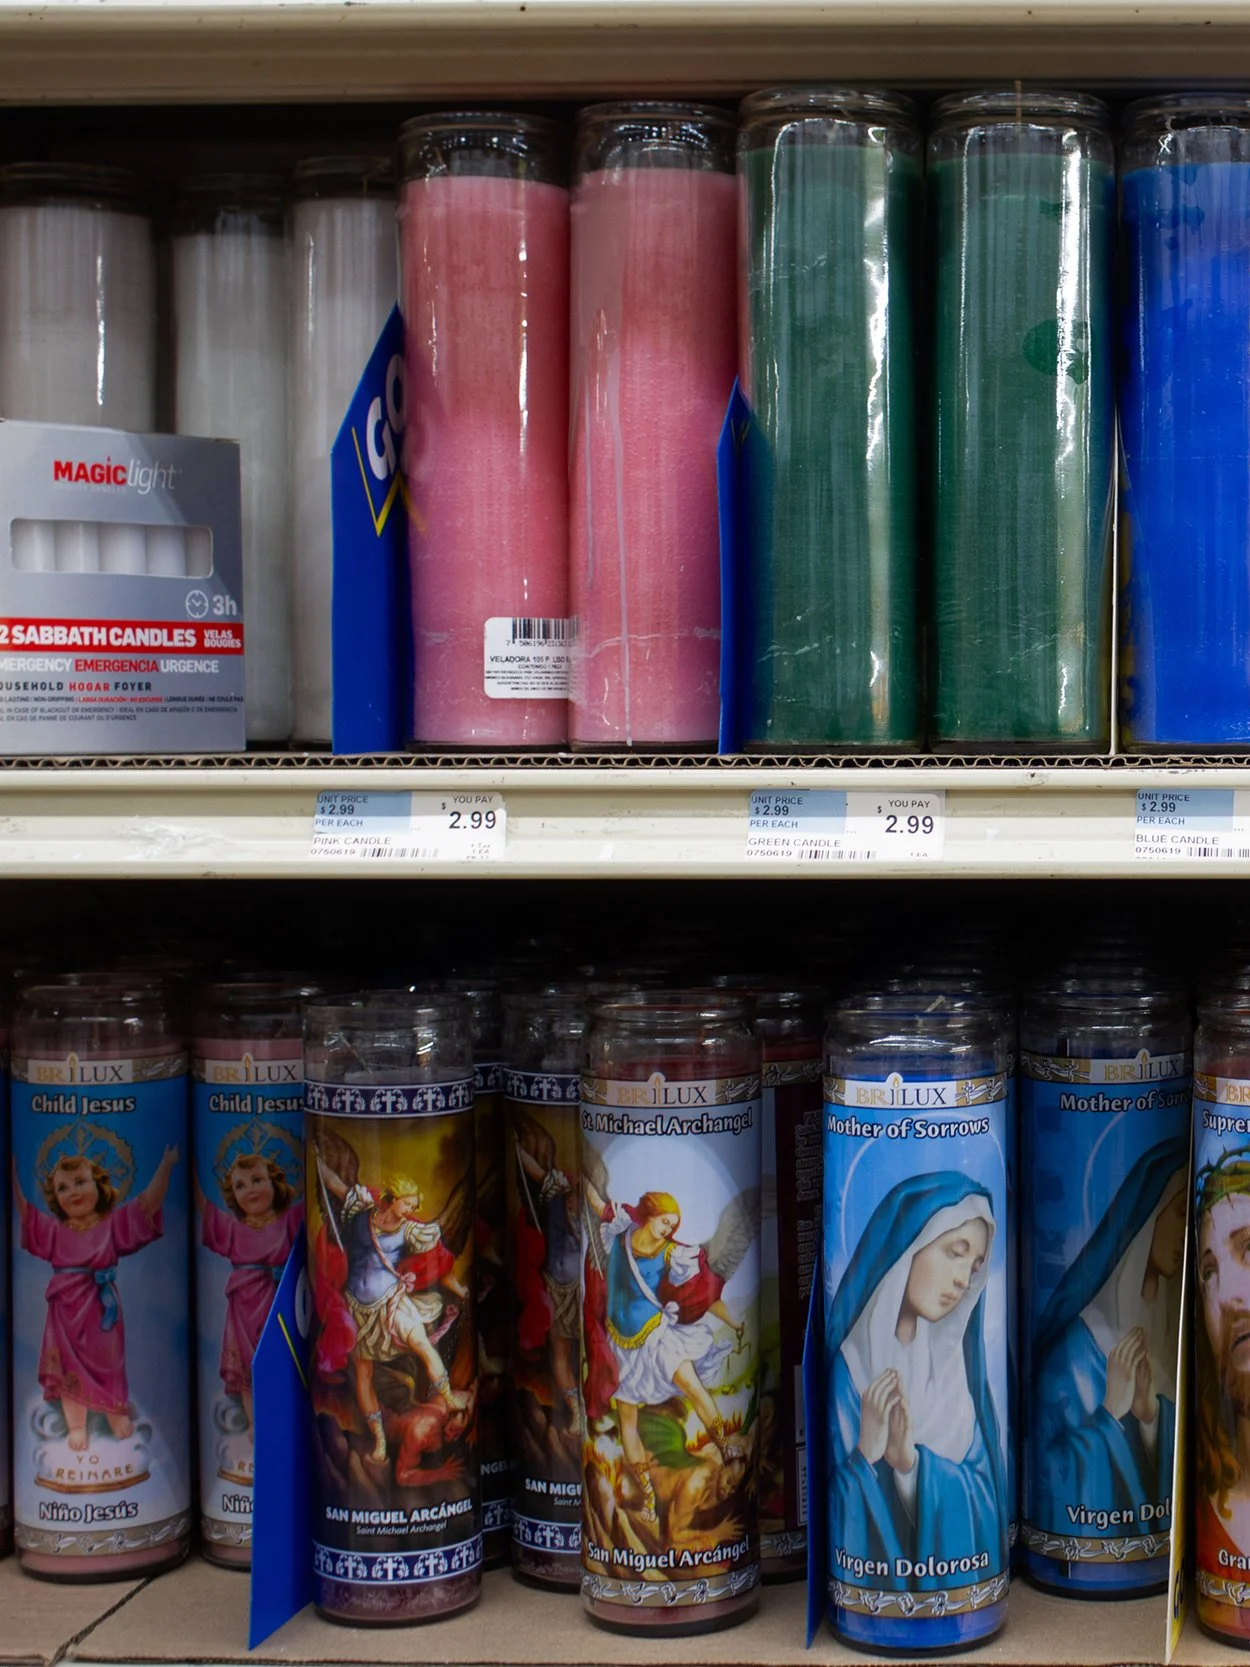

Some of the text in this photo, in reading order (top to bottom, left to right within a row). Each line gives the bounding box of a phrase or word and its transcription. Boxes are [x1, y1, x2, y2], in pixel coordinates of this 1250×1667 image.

[212, 595, 236, 616] 3h
[11, 625, 106, 645] SABBATH
[110, 627, 196, 647] CANDLES
[204, 629, 233, 639] VELAS
[204, 638, 241, 648] BOUGIES
[75, 659, 159, 672] EMERGENCIA
[161, 660, 219, 673] URGENCE
[69, 682, 110, 691] HOGAR
[115, 682, 152, 691] FOYER
[317, 795, 369, 804] UNIT PRICE
[452, 795, 494, 804] YOU PAY
[751, 796, 803, 805] UNIT PRICE
[888, 799, 930, 809] YOU PAY
[1138, 793, 1190, 802] UNIT PRICE
[337, 819, 363, 827] EACH
[750, 820, 798, 828] PER EACH
[1137, 816, 1185, 825] PER EACH
[313, 837, 391, 845] PINK CANDLE
[748, 838, 841, 847] GREEN CANDLE
[1136, 834, 1220, 845] BLUE CANDLE
[32, 1094, 136, 1114] Child Jesus
[208, 1092, 251, 1112] Child
[1059, 1088, 1158, 1112] Mother of
[596, 1113, 664, 1136] Michael
[665, 1107, 752, 1136] Archangel
[827, 1114, 989, 1139] Mother of Sorrows
[525, 1478, 547, 1493] SAN
[39, 1500, 138, 1524] Niño Jesús
[325, 1498, 473, 1524] SAN MIGUEL ARCÁNGEL
[1066, 1505, 1134, 1530] Virgen
[356, 1521, 447, 1536] Saint Michael Archangel
[587, 1534, 749, 1572] San Miguel Arcángel
[835, 1548, 989, 1578] Virgen Dolorosa
